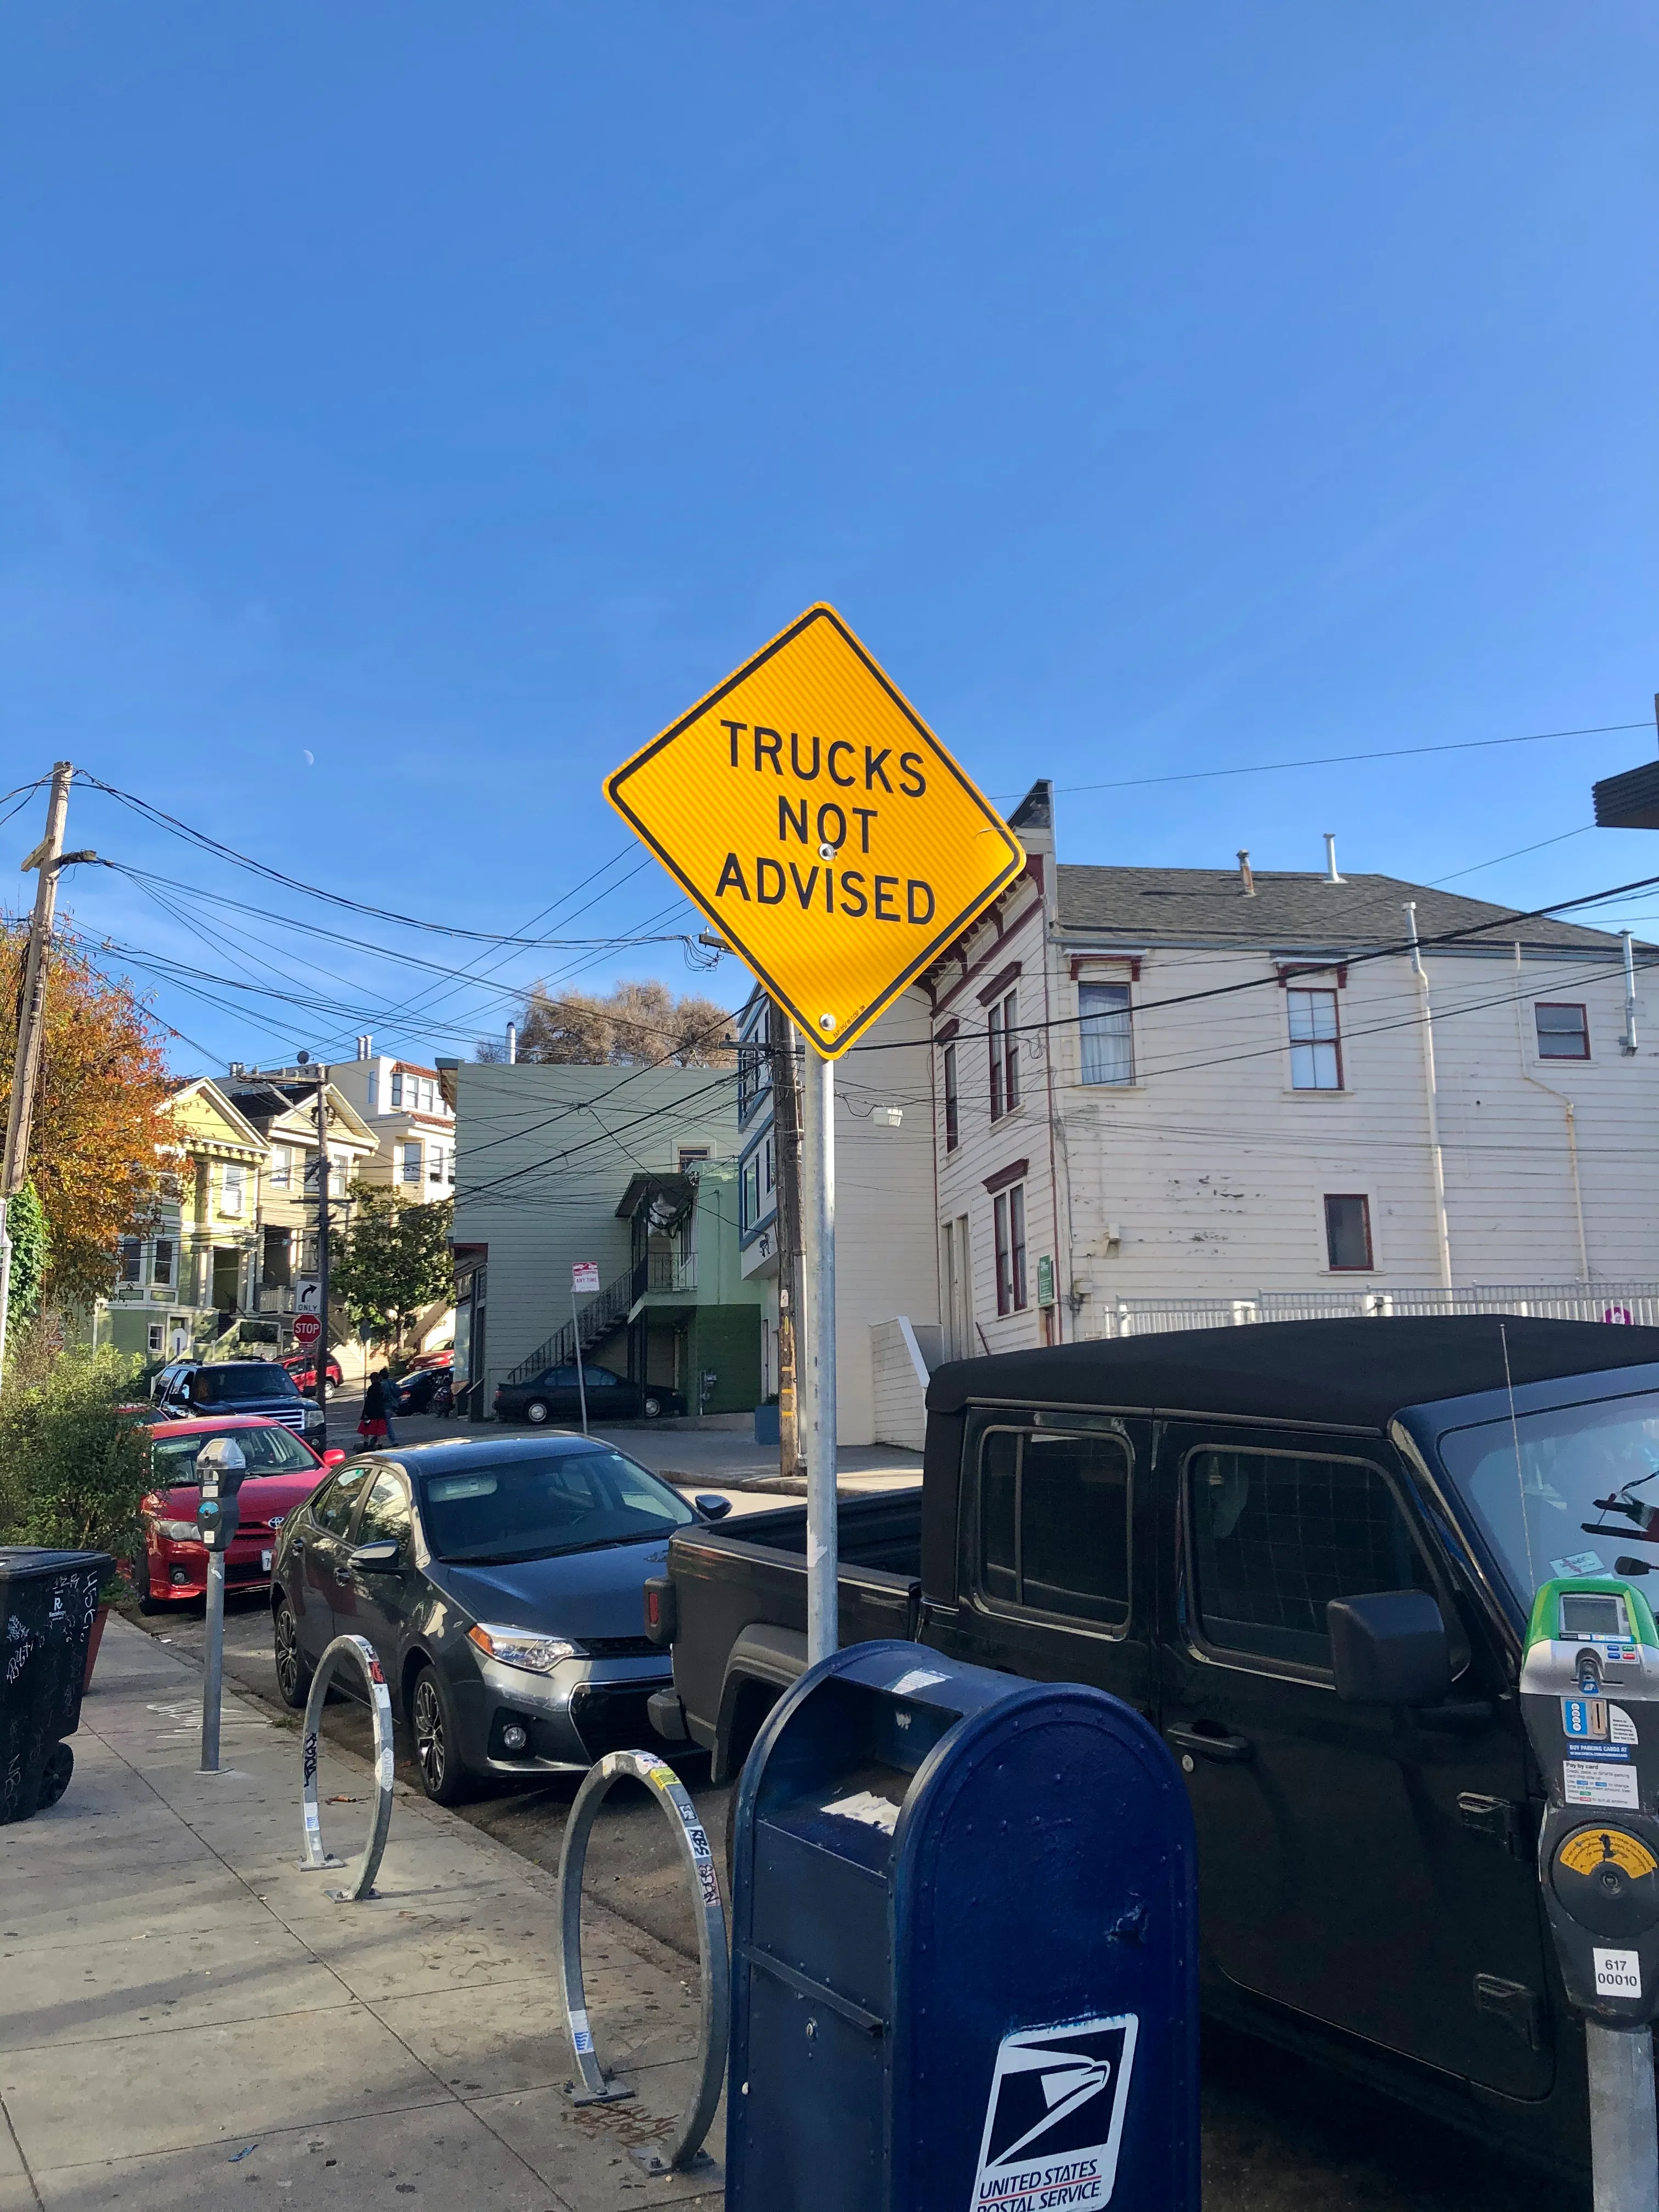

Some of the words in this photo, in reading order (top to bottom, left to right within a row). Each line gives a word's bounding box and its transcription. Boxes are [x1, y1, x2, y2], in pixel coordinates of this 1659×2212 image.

[720, 719, 928, 798] TRUCKS
[778, 794, 878, 854] NOT
[714, 851, 936, 926] ADVISED
[295, 1323, 319, 1334] STOP
[384, 1752, 392, 1787] OVENS
[690, 1829, 710, 1857] RBS
[1598, 1973, 1637, 1987] 00010
[1605, 1959, 1627, 1971] 617
[979, 2171, 1042, 2199] UNITED
[1043, 2158, 1098, 2186] STATES
[1039, 2180, 1102, 2210] SERVICE
